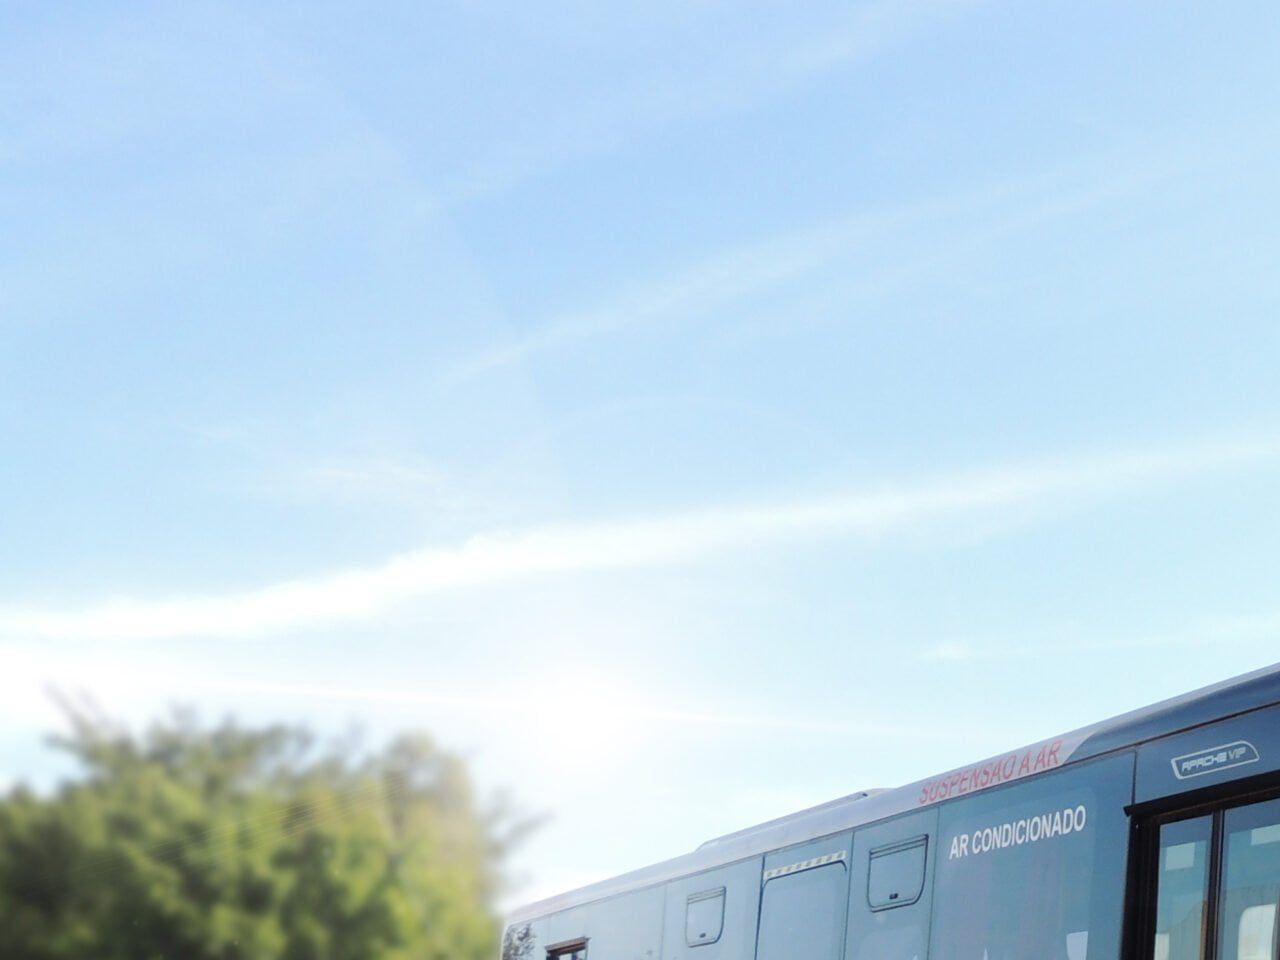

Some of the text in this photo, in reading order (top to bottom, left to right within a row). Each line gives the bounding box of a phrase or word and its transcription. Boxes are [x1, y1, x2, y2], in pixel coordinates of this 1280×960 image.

[1034, 740, 1063, 769] AR
[949, 805, 1087, 860] AR CONDICIONADO
